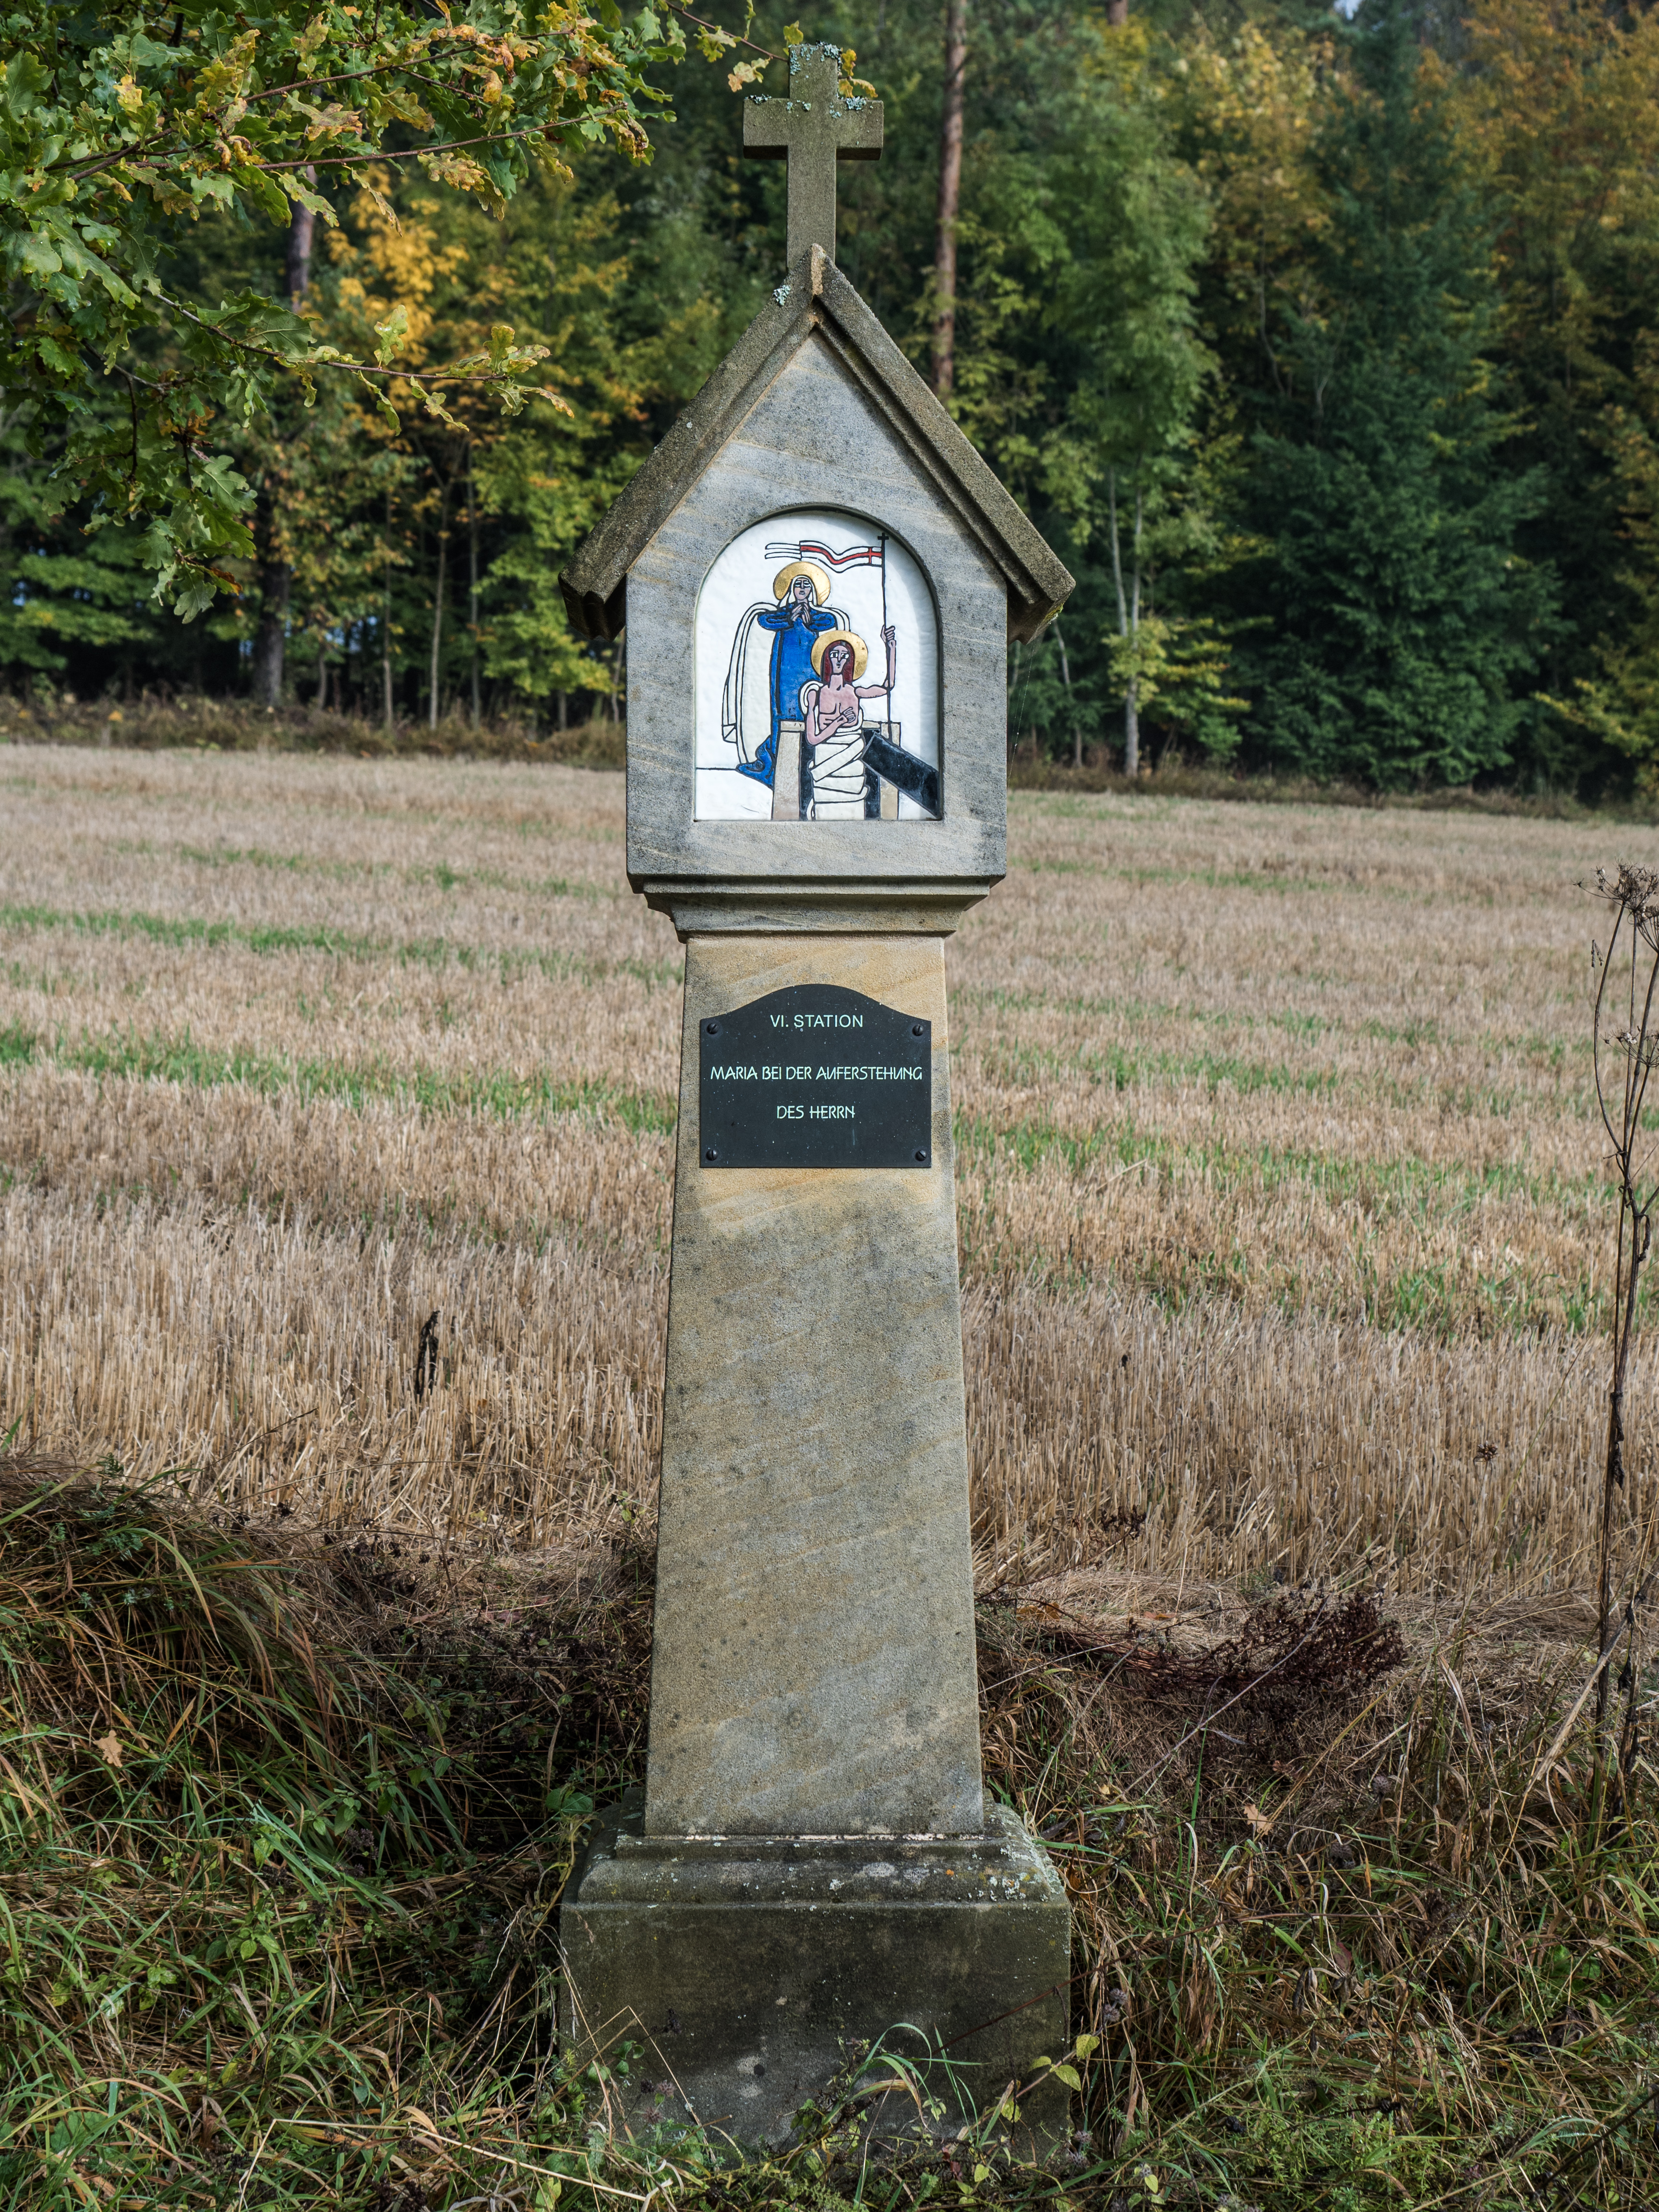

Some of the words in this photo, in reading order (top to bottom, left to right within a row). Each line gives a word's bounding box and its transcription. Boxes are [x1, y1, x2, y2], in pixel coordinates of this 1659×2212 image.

[770, 1014, 789, 1027] VI.
[793, 1014, 863, 1028] STATION
[710, 1066, 757, 1080] MARIA
[762, 1066, 781, 1080] BEI
[786, 1066, 812, 1080] DER
[816, 1066, 922, 1080] AUFERSTEHUNG
[777, 1105, 804, 1119] DES
[809, 1105, 855, 1119] HERRN
